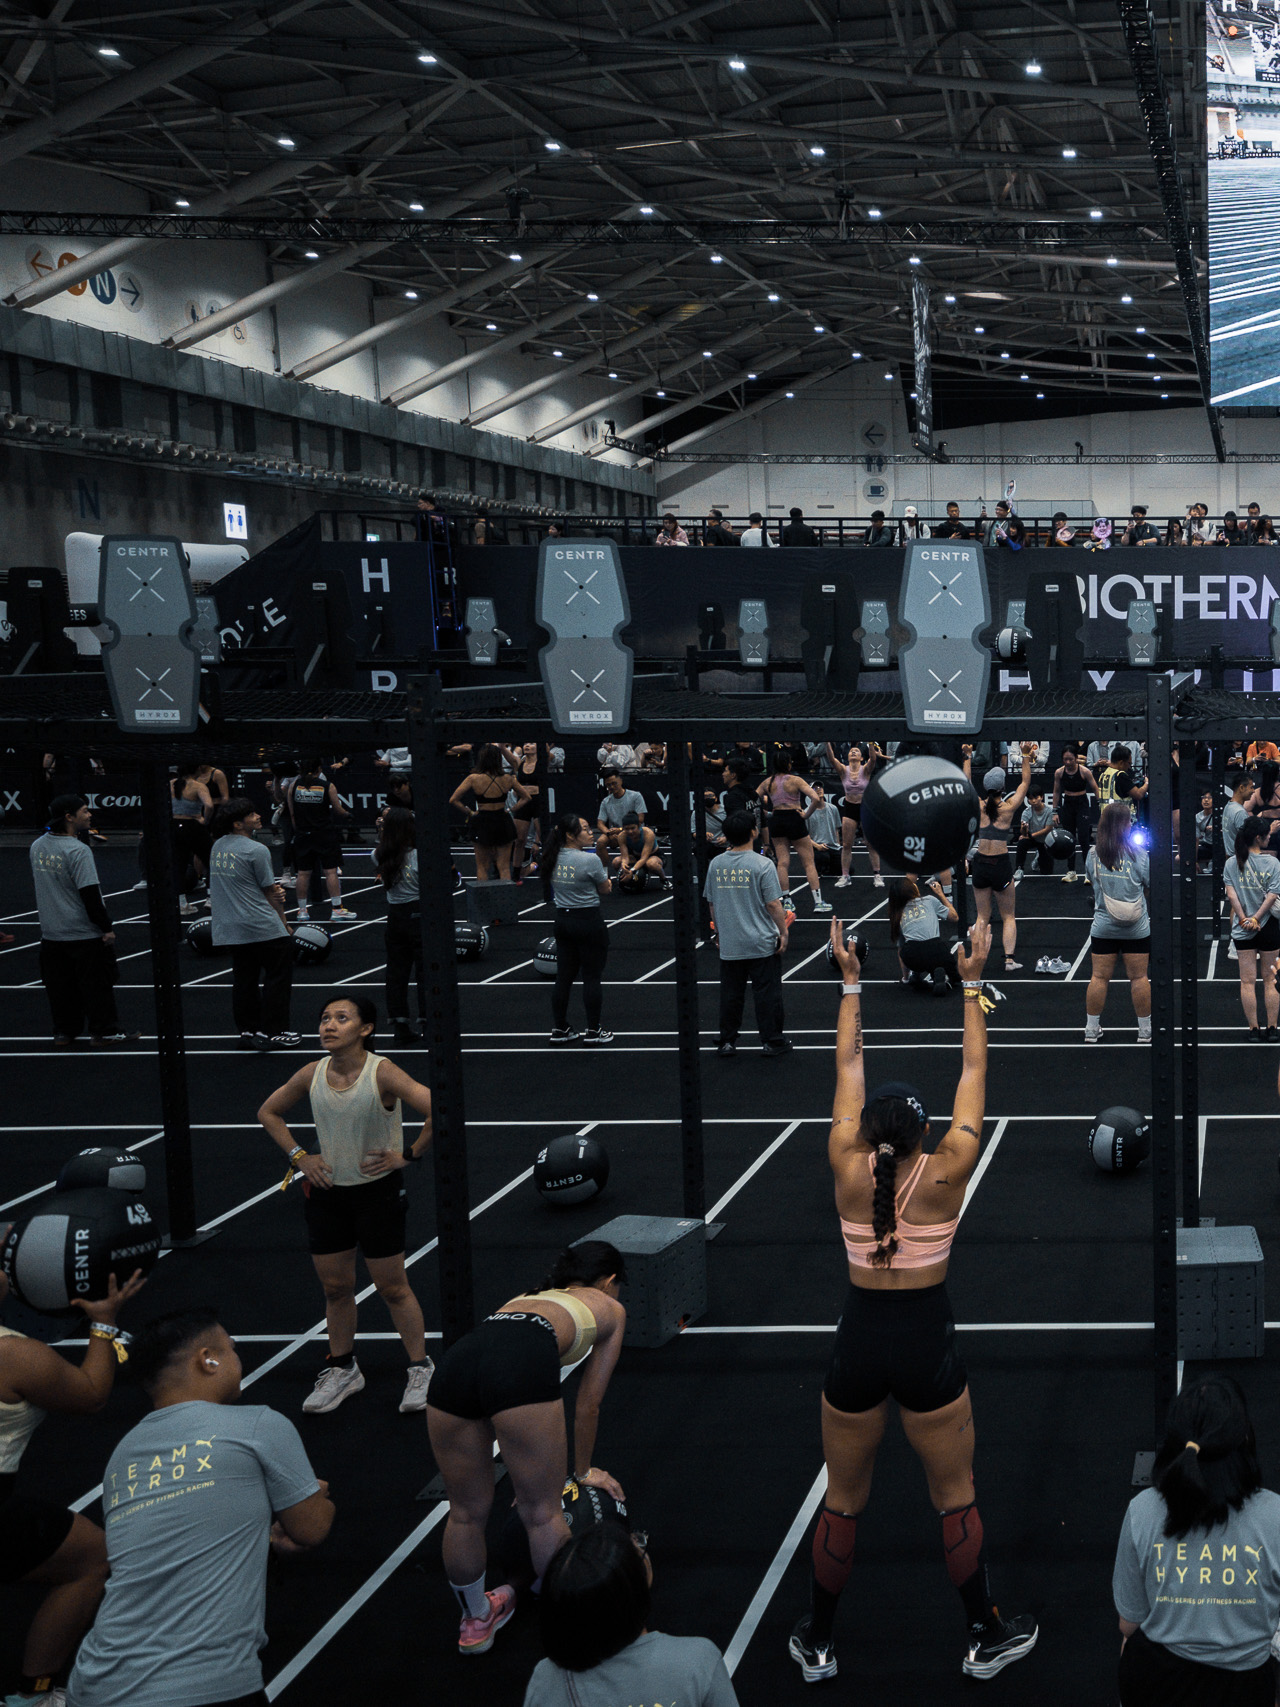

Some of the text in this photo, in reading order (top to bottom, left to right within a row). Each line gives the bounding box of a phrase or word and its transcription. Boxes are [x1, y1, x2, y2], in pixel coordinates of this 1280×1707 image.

[117, 547, 169, 557] CENTR
[555, 550, 606, 560] CENTR
[920, 551, 970, 562] CENTR
[908, 783, 964, 805] CENTR
[904, 836, 925, 851] KG
[296, 939, 318, 950] CENTR
[545, 1173, 583, 1188] CENTR
[74, 1228, 90, 1292] CENTR
[110, 1444, 187, 1489] TEAM
[110, 1456, 212, 1506] HYROX
[156, 1490, 184, 1503] FITNESS
[186, 1480, 215, 1493] RACING
[1153, 1544, 1237, 1562] TEAM
[1156, 1566, 1258, 1586] HYROX
